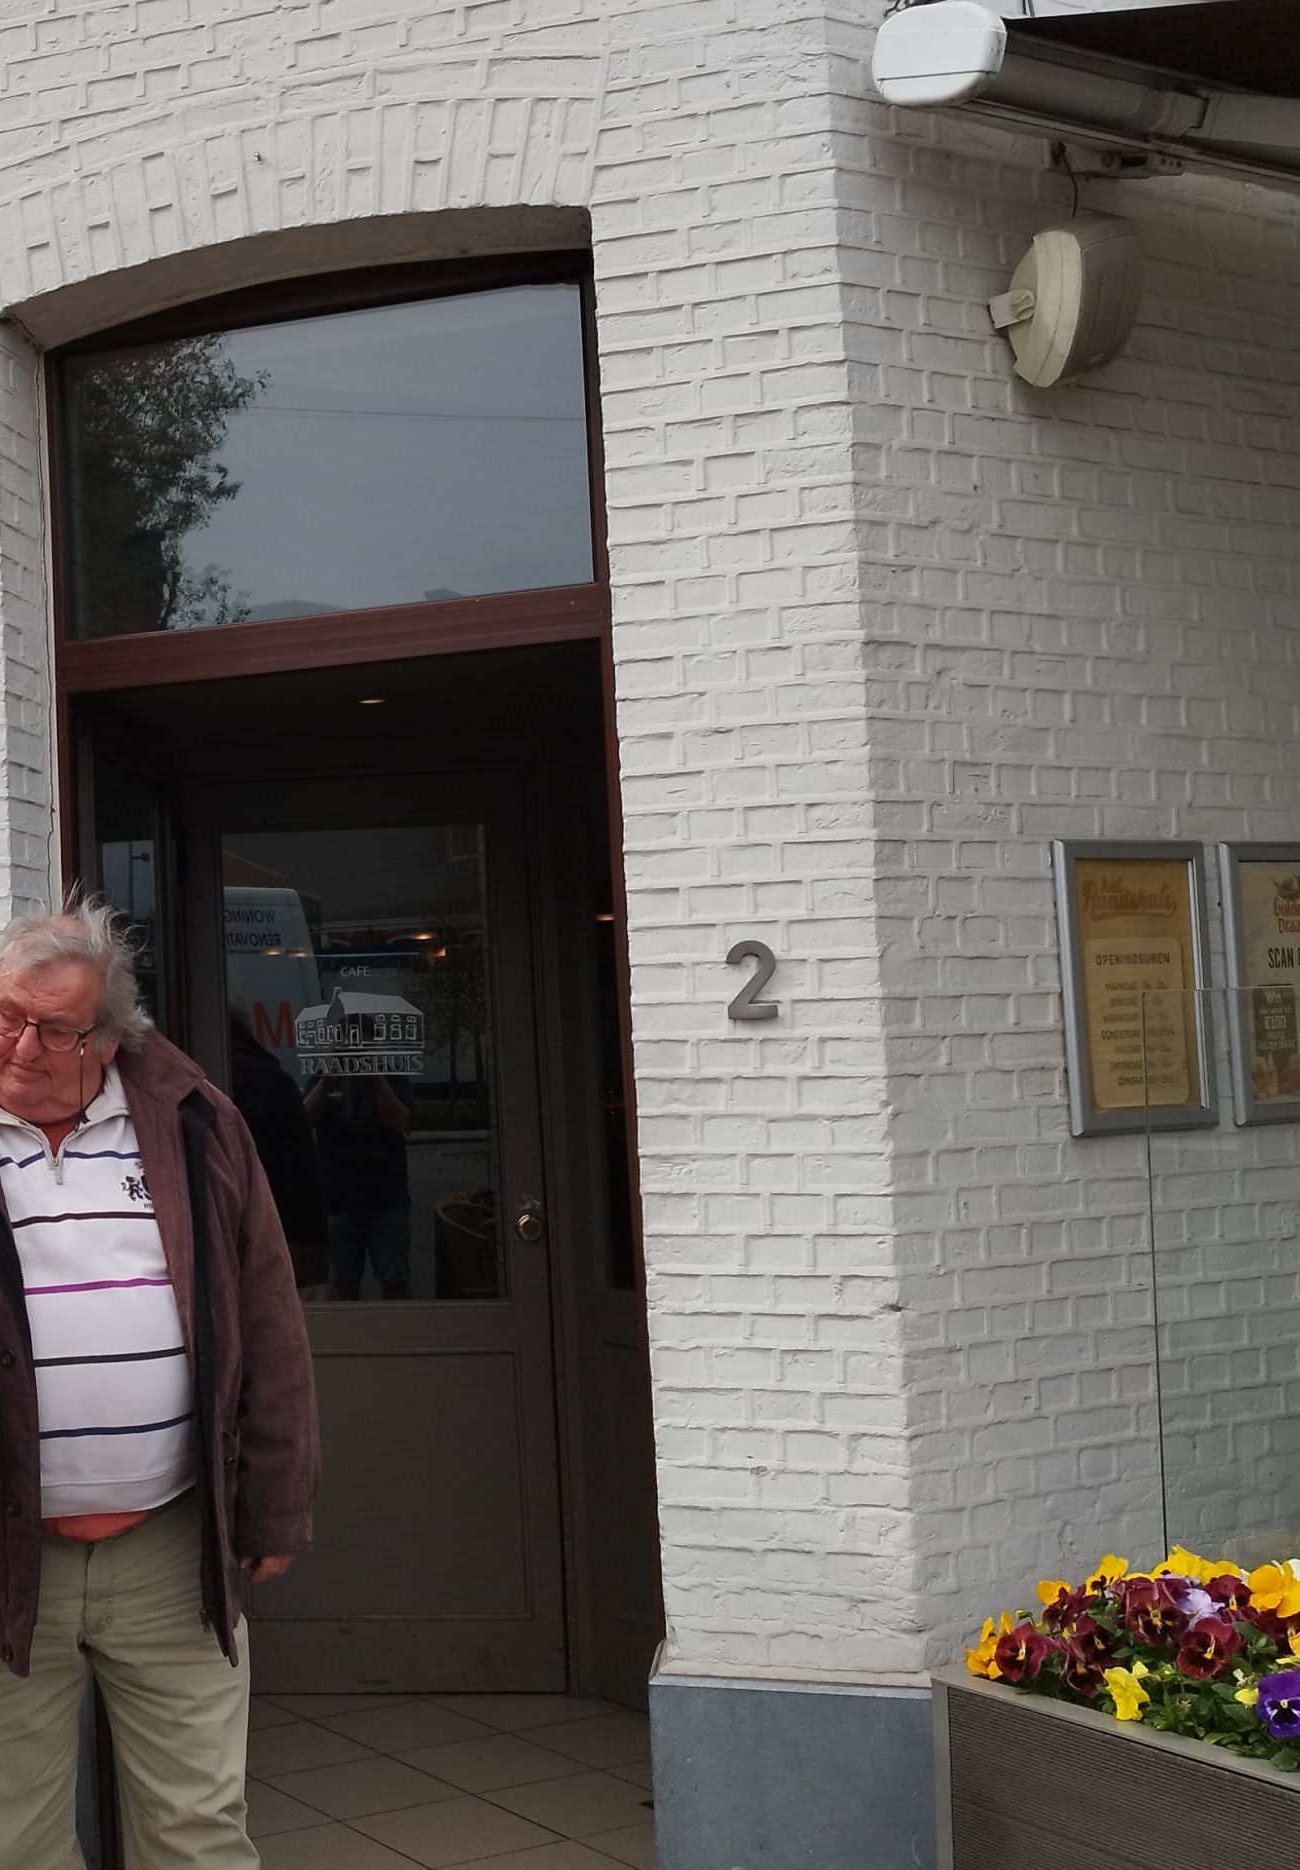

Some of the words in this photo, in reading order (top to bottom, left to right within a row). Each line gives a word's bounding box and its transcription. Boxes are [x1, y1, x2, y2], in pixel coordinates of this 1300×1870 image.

[1095, 952, 1171, 966] OPENINGSUREN
[1268, 947, 1294, 969] SCAN
[340, 965, 372, 977] CAFE
[725, 939, 778, 1019] 2
[300, 1055, 425, 1075] RAADSHUIS
